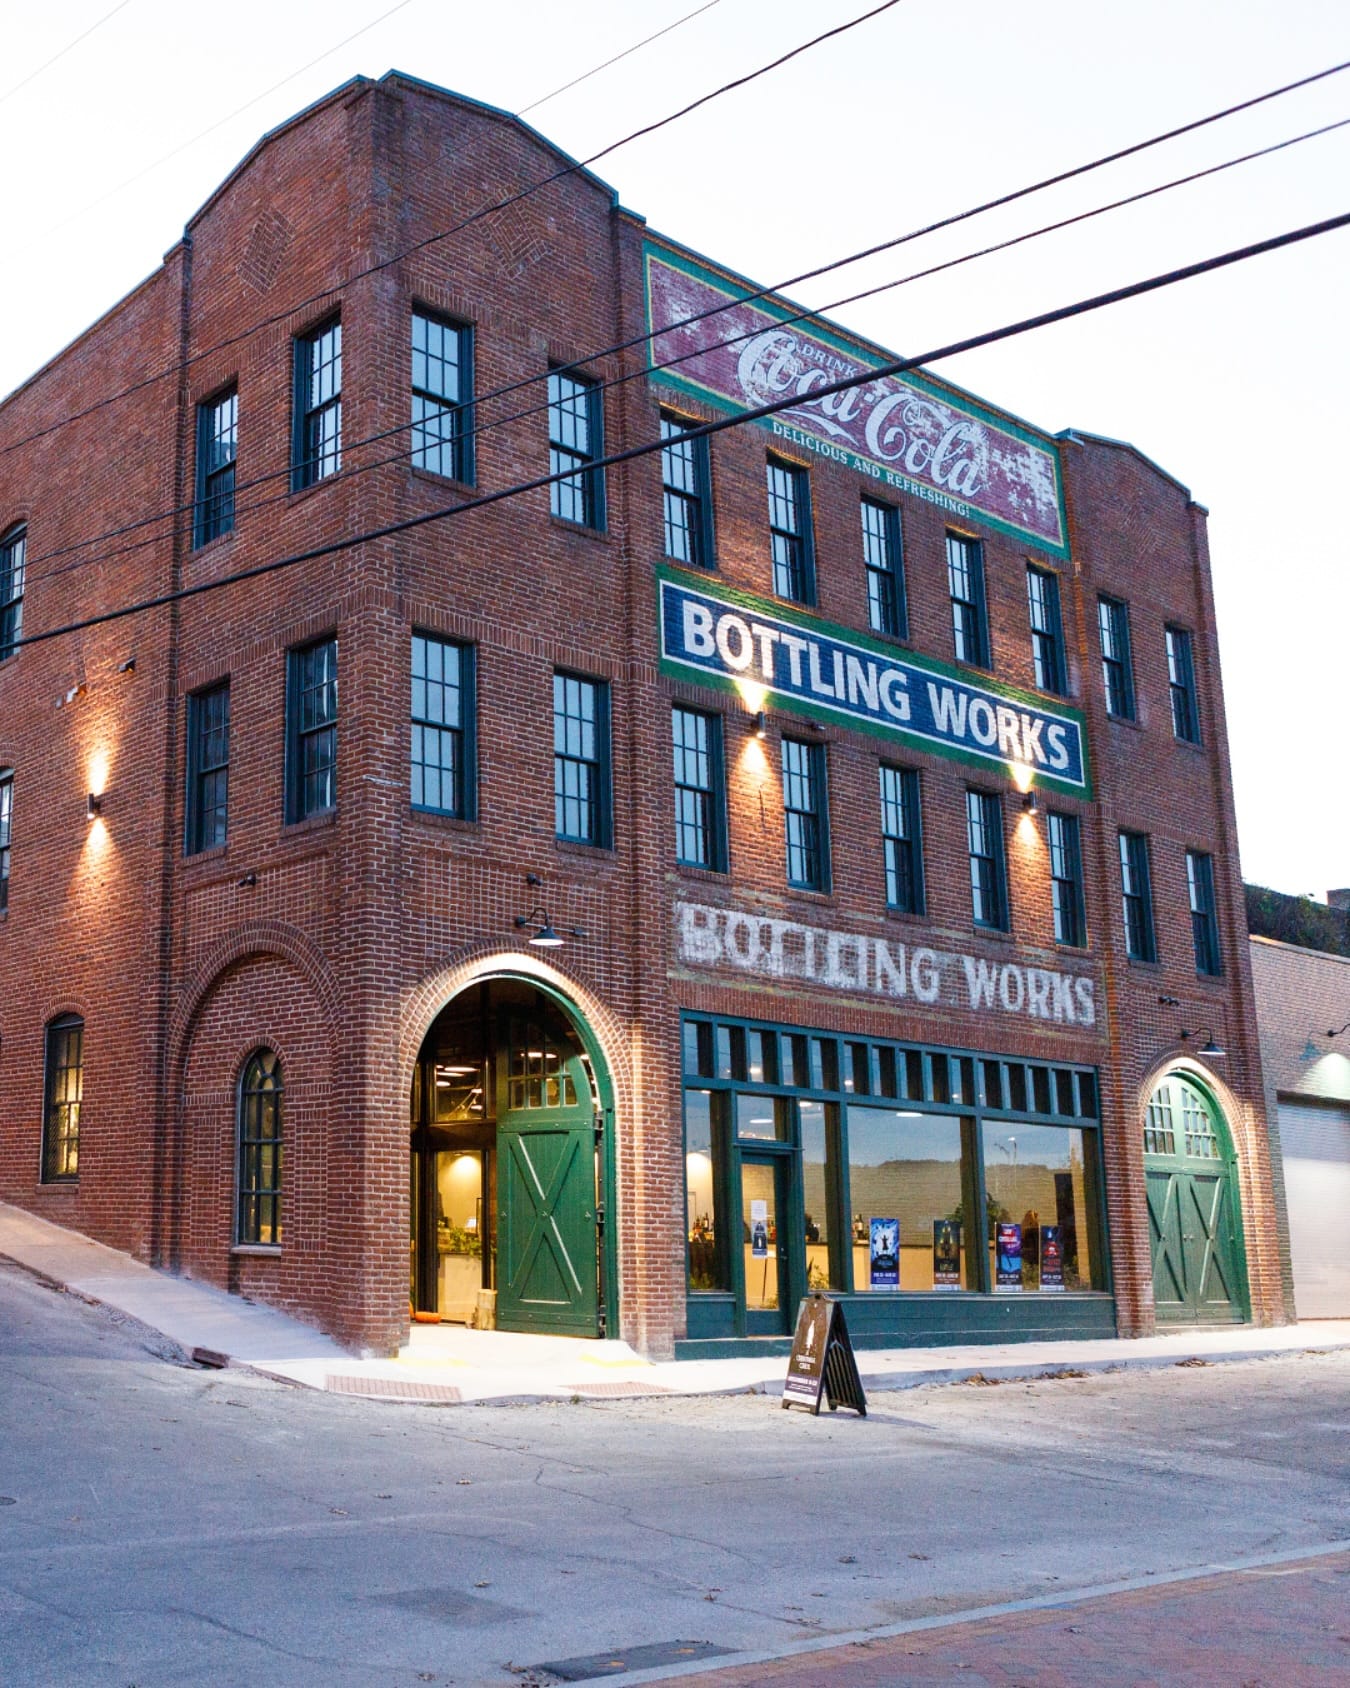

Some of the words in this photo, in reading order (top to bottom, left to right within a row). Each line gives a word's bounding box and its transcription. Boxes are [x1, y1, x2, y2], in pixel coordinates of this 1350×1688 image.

[738, 329, 982, 498] Coca-Cola
[801, 343, 858, 377] DRINK
[773, 422, 849, 466] DELICIOUS
[853, 458, 881, 479] AND
[886, 472, 971, 519] REFRESHING!
[683, 602, 911, 722] BOTTLING
[925, 682, 1070, 771] WORKS
[675, 901, 941, 1003] BOTTLING
[962, 954, 1097, 1027] WORKS
